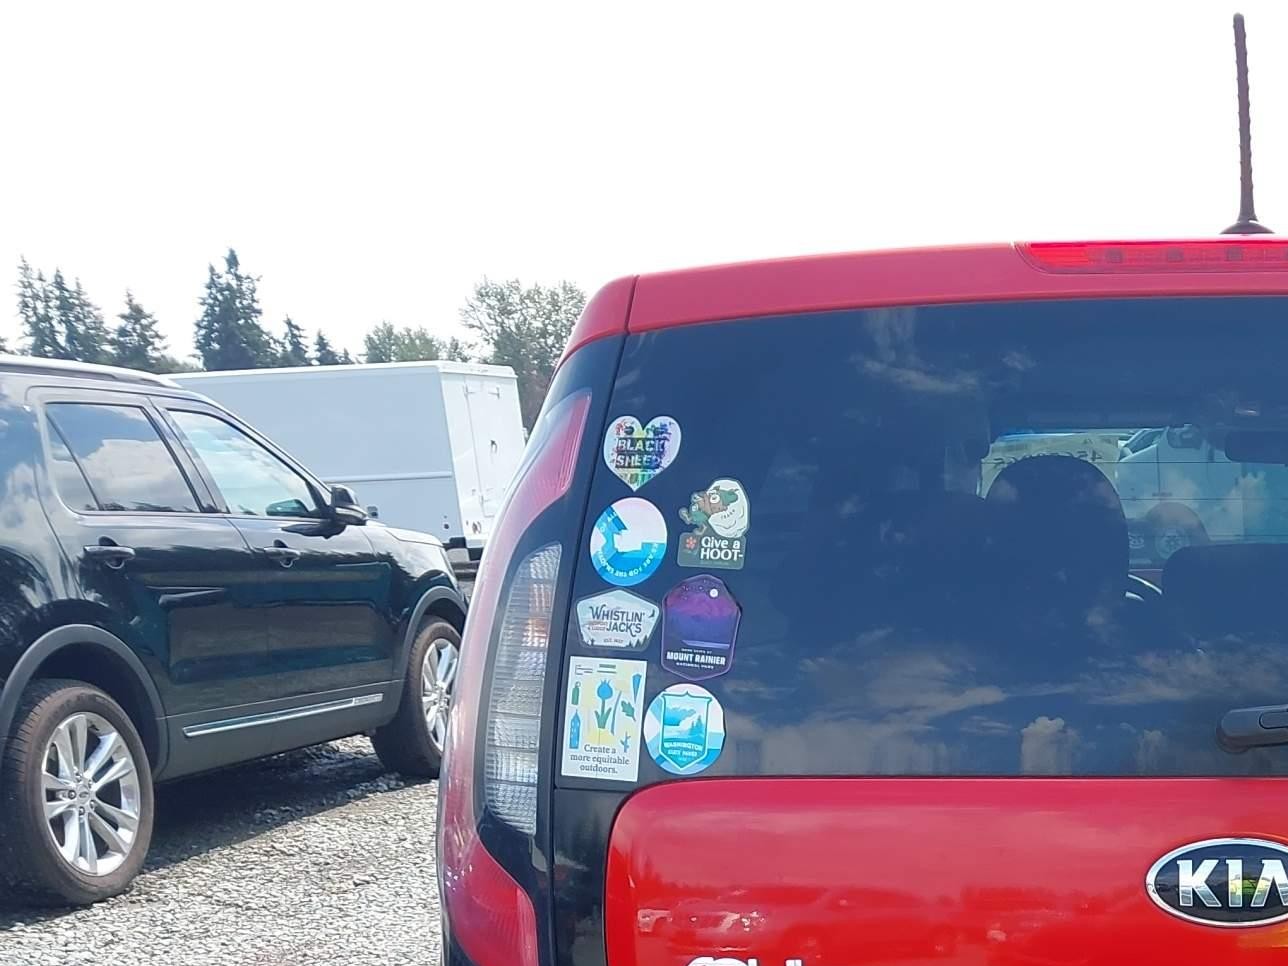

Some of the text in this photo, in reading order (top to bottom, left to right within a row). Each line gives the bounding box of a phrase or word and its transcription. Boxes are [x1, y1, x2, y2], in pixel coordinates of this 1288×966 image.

[616, 438, 666, 452] BLACK
[615, 454, 660, 467] SHEEP
[701, 536, 741, 549] Give a
[589, 604, 646, 623] WHISTLIN'
[606, 622, 642, 637] JACK'S
[666, 651, 694, 663] MOUNT
[695, 654, 726, 666] RAINIER
[584, 743, 611, 754] Create
[570, 754, 630, 765] more equitable
[579, 764, 618, 774] outdoors.
